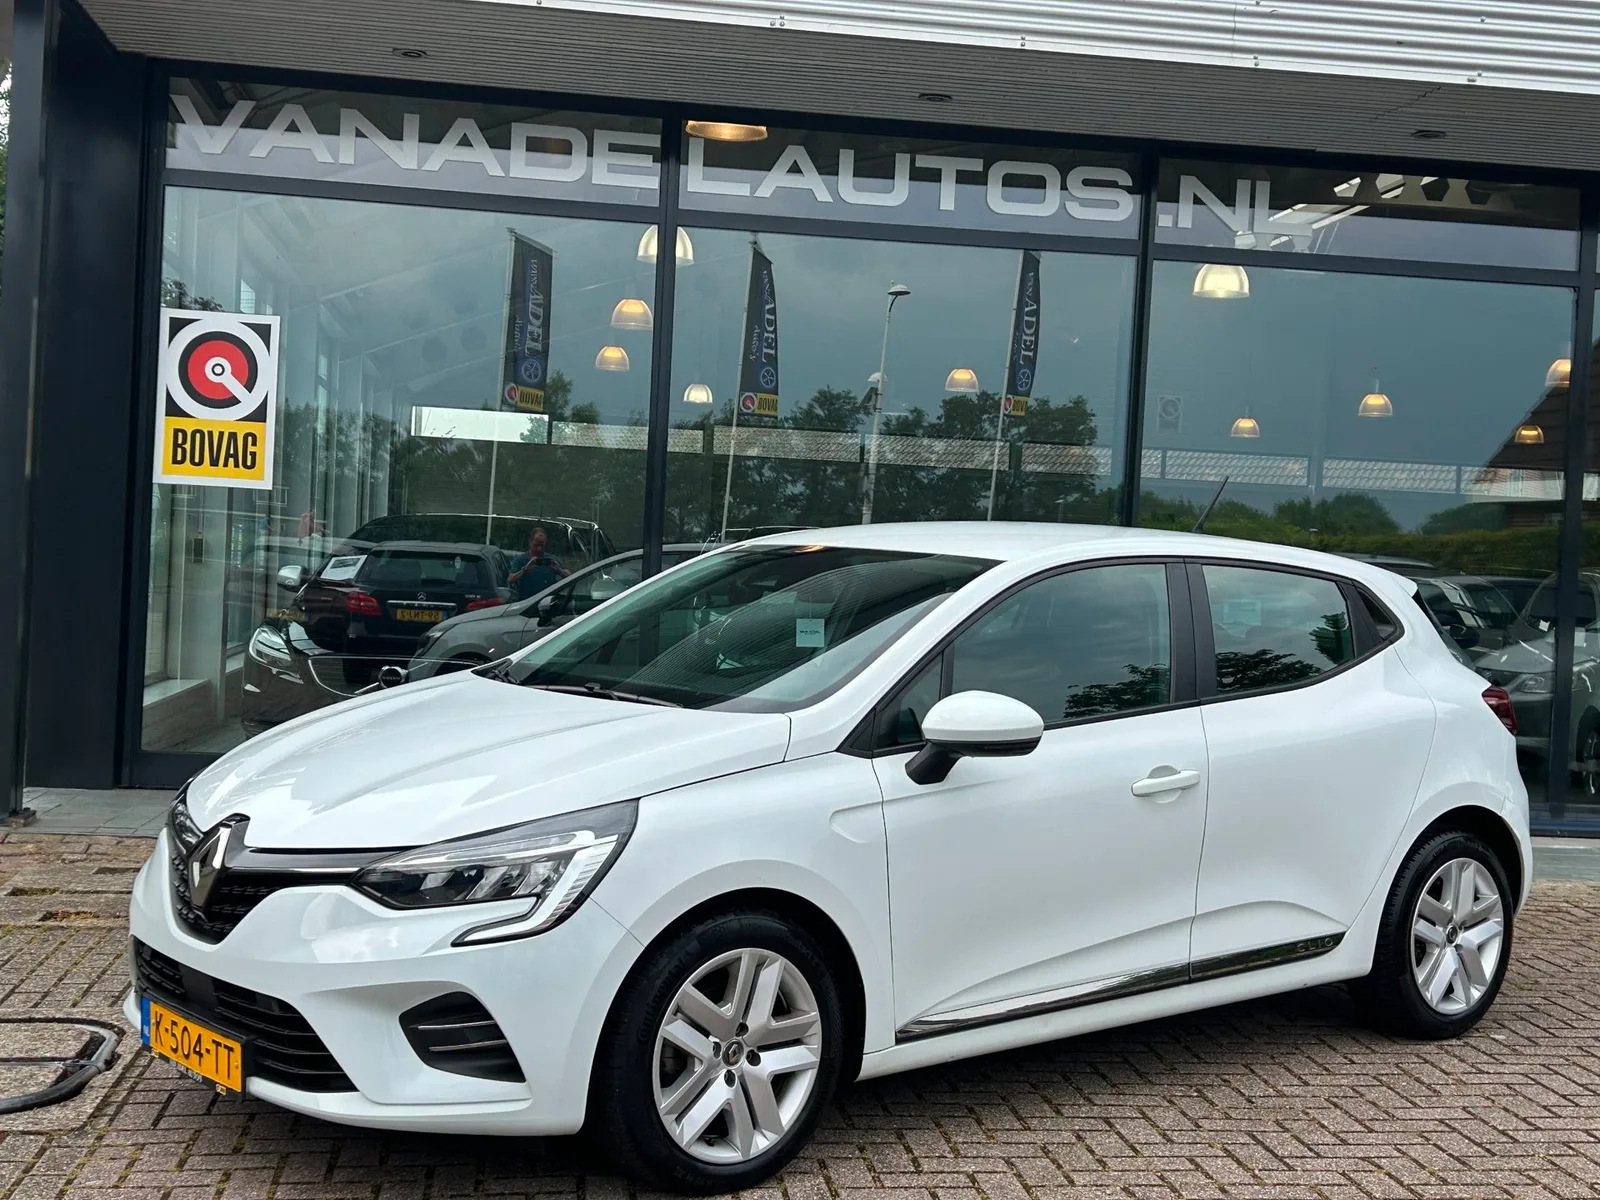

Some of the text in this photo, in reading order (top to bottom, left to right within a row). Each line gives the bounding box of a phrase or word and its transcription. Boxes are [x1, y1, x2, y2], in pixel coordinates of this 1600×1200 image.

[762, 292, 776, 363] ADEL
[1019, 298, 1037, 364] ADEL
[171, 427, 258, 470] BOVAG
[1297, 937, 1333, 952] CLIO
[154, 1010, 235, 1081] K-504-TT
